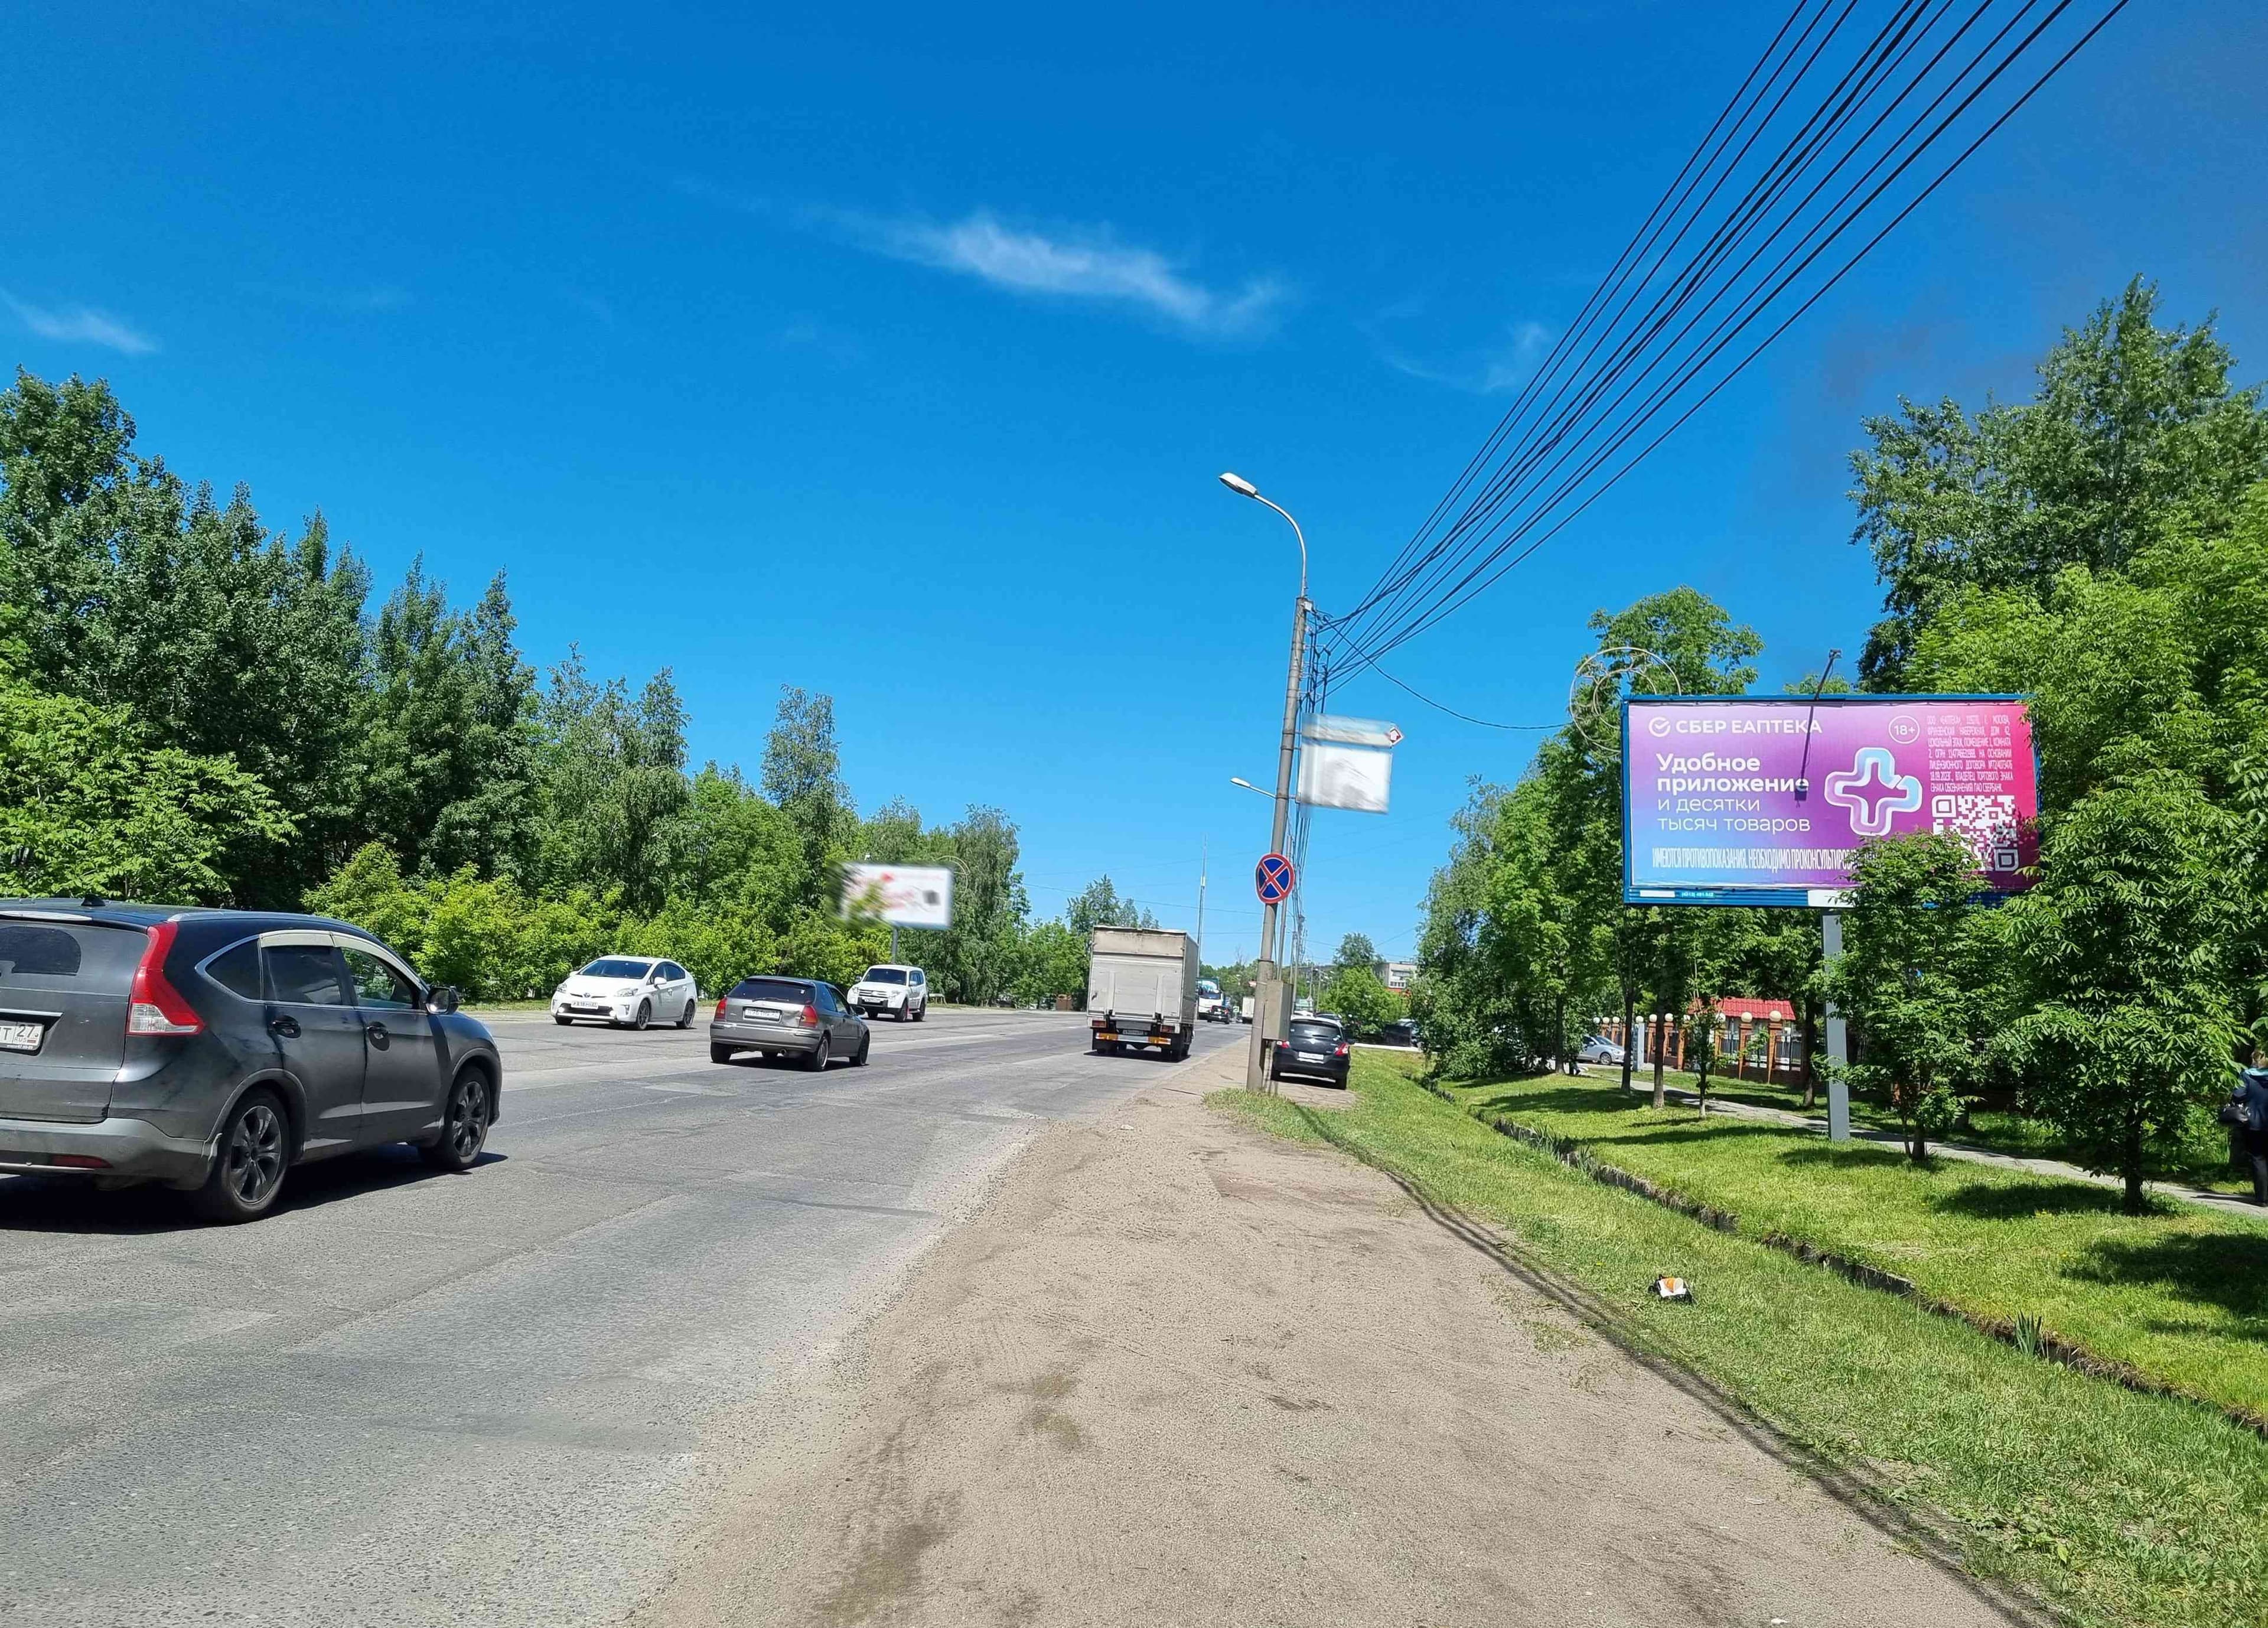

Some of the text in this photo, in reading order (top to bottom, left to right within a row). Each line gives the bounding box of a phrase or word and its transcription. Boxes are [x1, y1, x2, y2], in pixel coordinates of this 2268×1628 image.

[1676, 720, 1823, 734] СБЕР ЕАПТЕКА
[1894, 725, 1915, 735] 18+
[1656, 753, 1760, 774] Удобное
[1657, 777, 1809, 795] приложение
[1658, 799, 1761, 813] и десятки
[1657, 818, 1811, 835] тысяч товаров
[1748, 849, 1791, 873] НЕОБХОДИМО
[17, 1024, 35, 1037] 27
